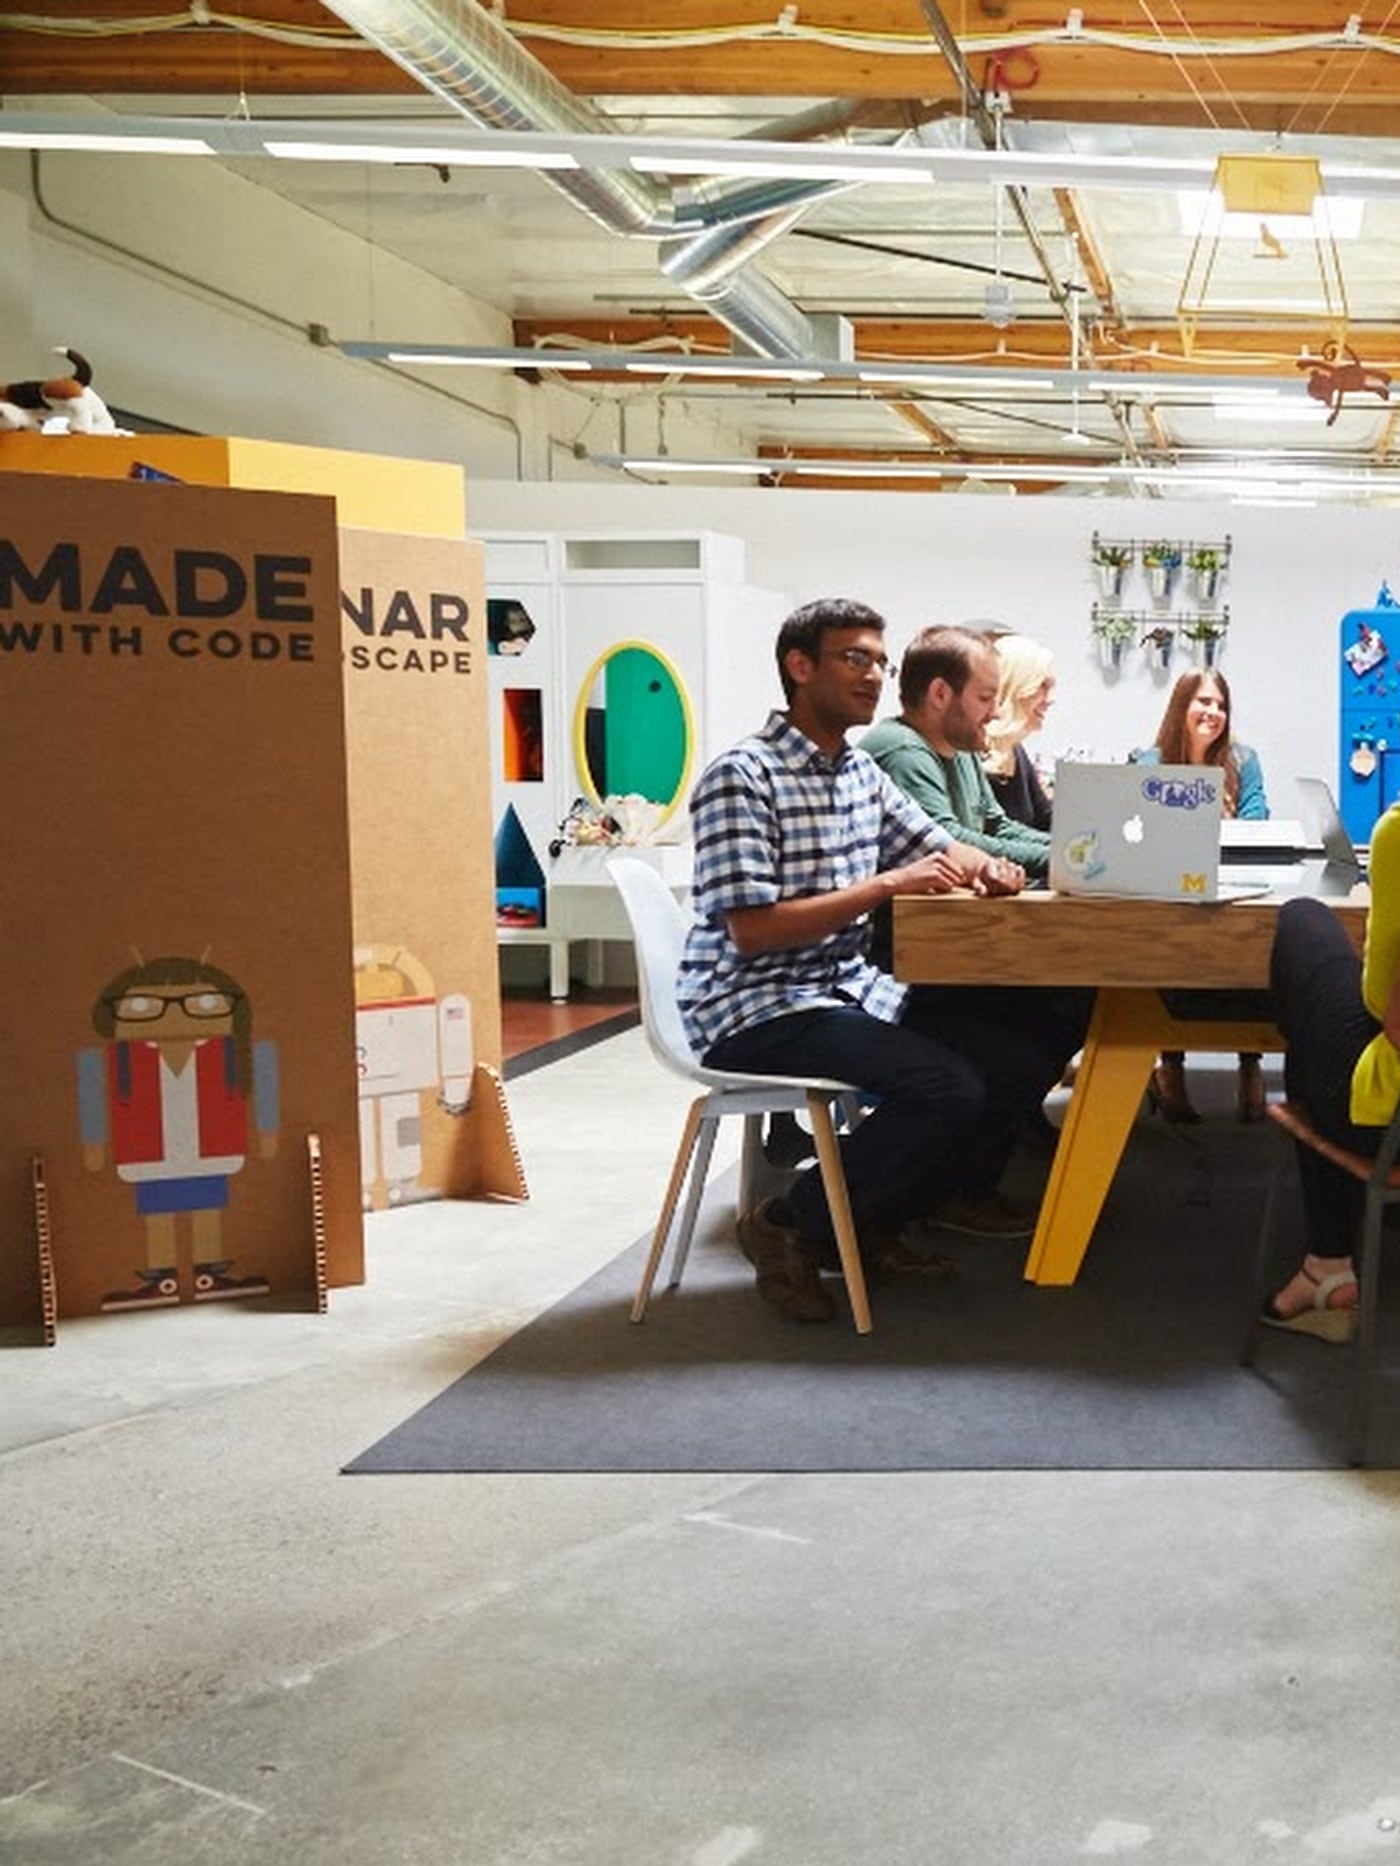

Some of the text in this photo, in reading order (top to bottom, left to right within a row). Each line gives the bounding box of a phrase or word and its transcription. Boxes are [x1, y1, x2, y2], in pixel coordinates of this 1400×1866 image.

[0, 540, 314, 622] MADE
[0, 622, 314, 662] WITH CODE
[342, 645, 472, 675] SCAPE
[1182, 873, 1208, 894] M
